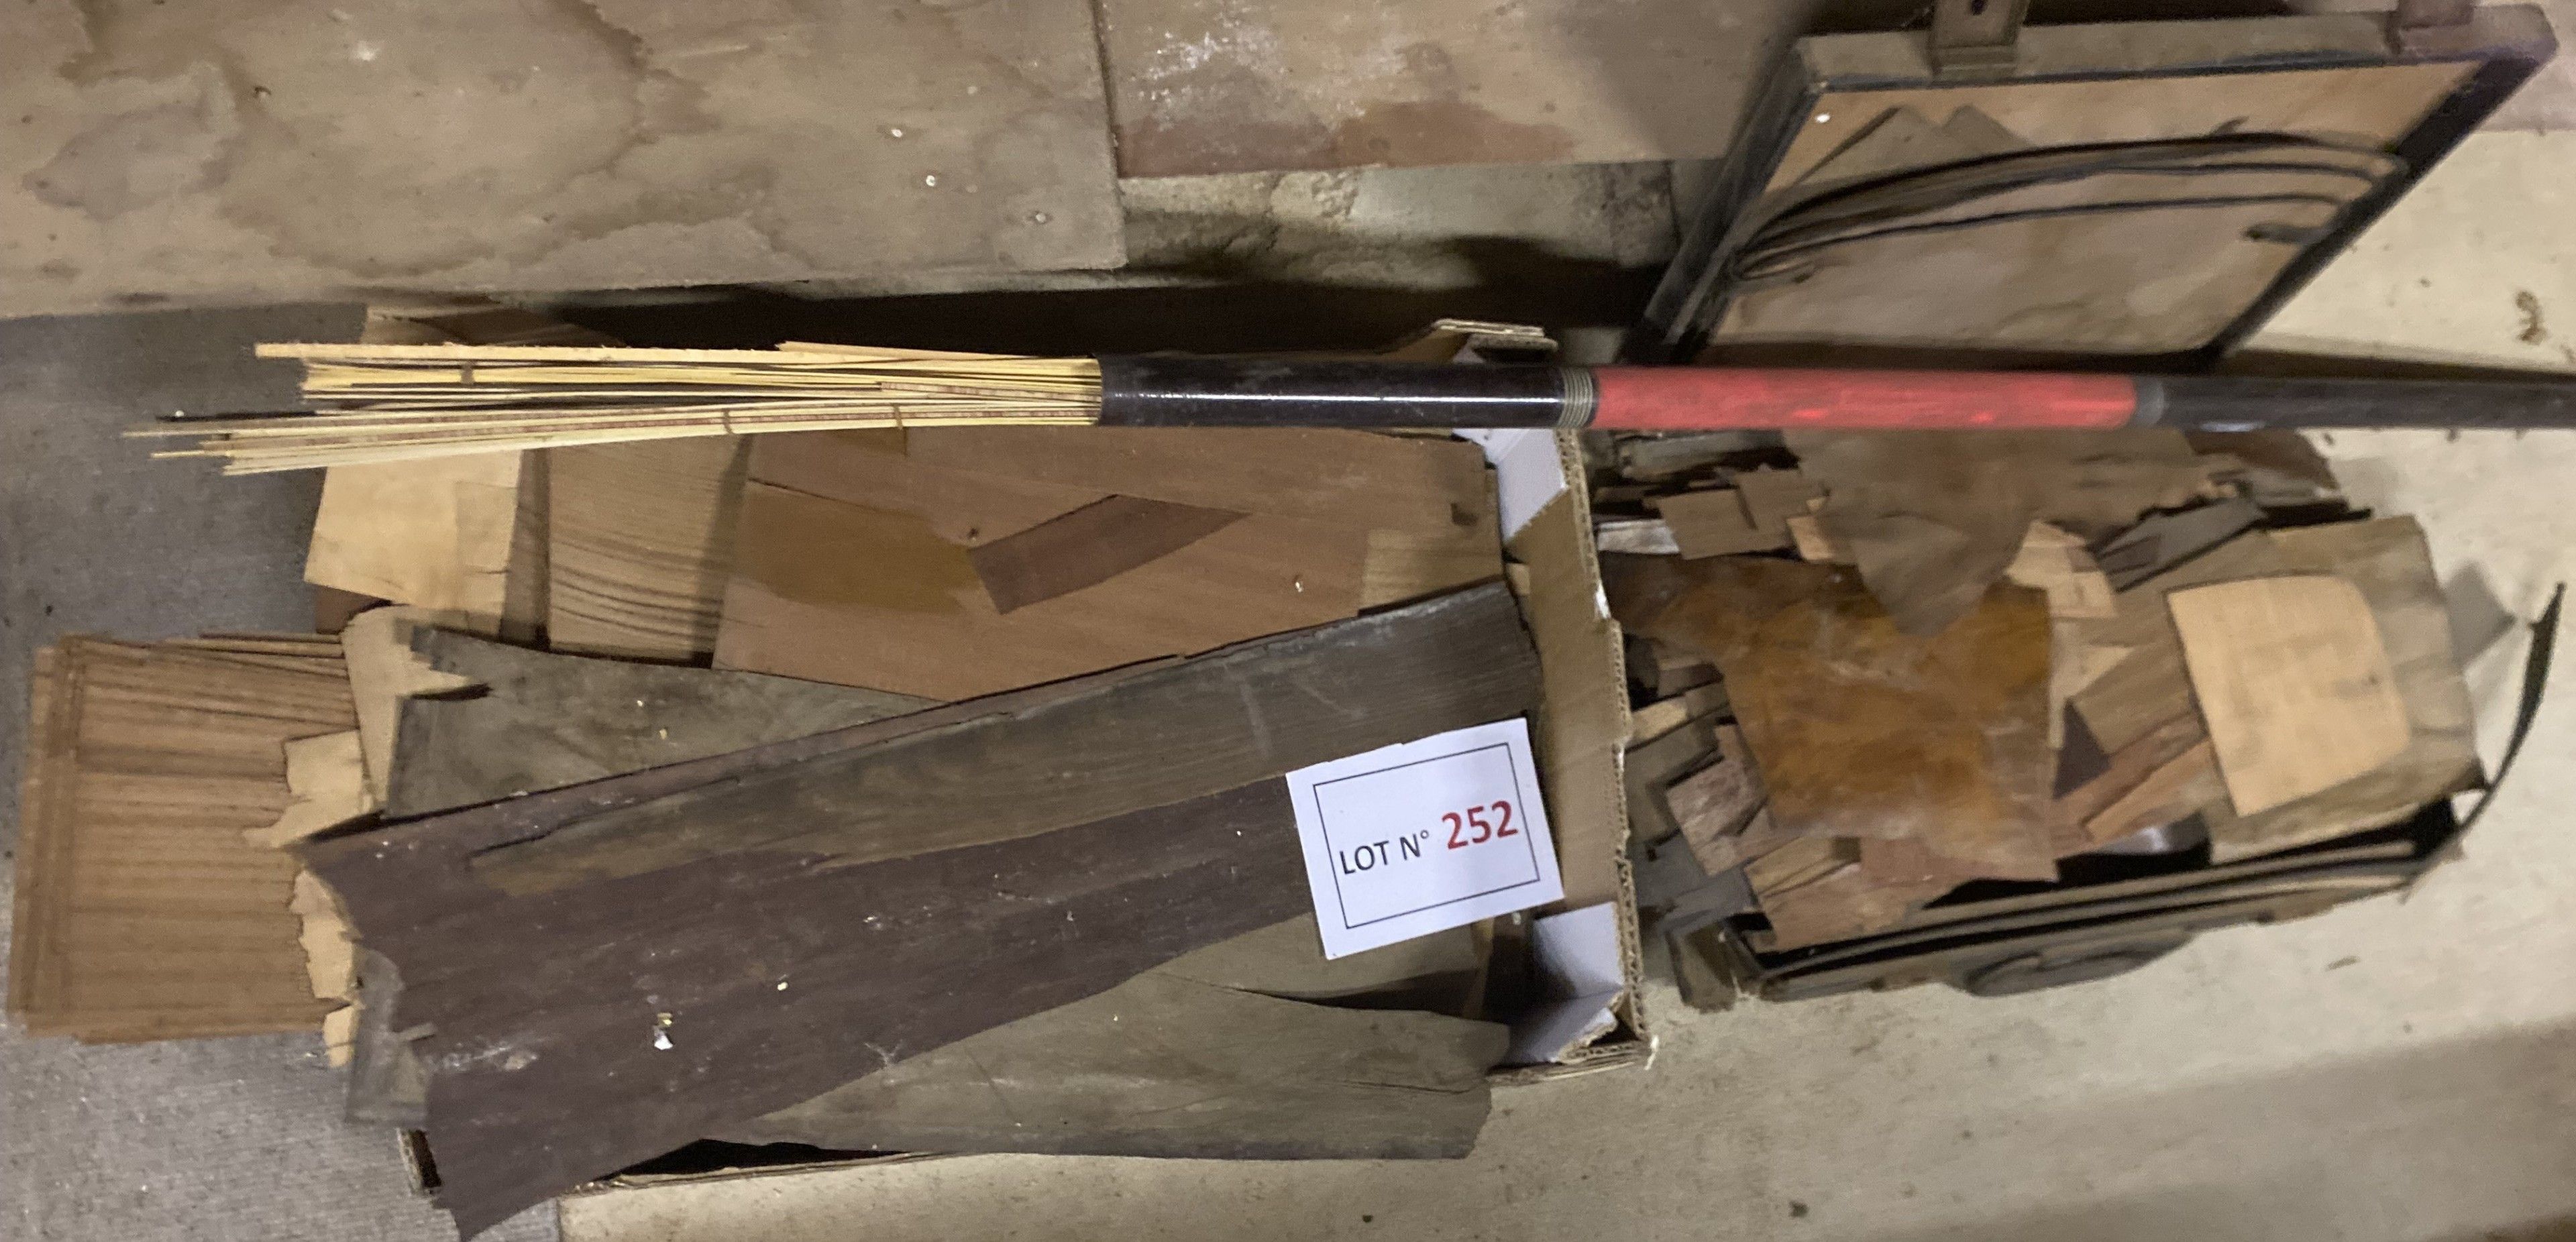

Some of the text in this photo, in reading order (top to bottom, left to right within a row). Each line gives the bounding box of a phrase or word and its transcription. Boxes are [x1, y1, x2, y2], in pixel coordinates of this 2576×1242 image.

[1340, 801, 1518, 874] LOT N° 252
